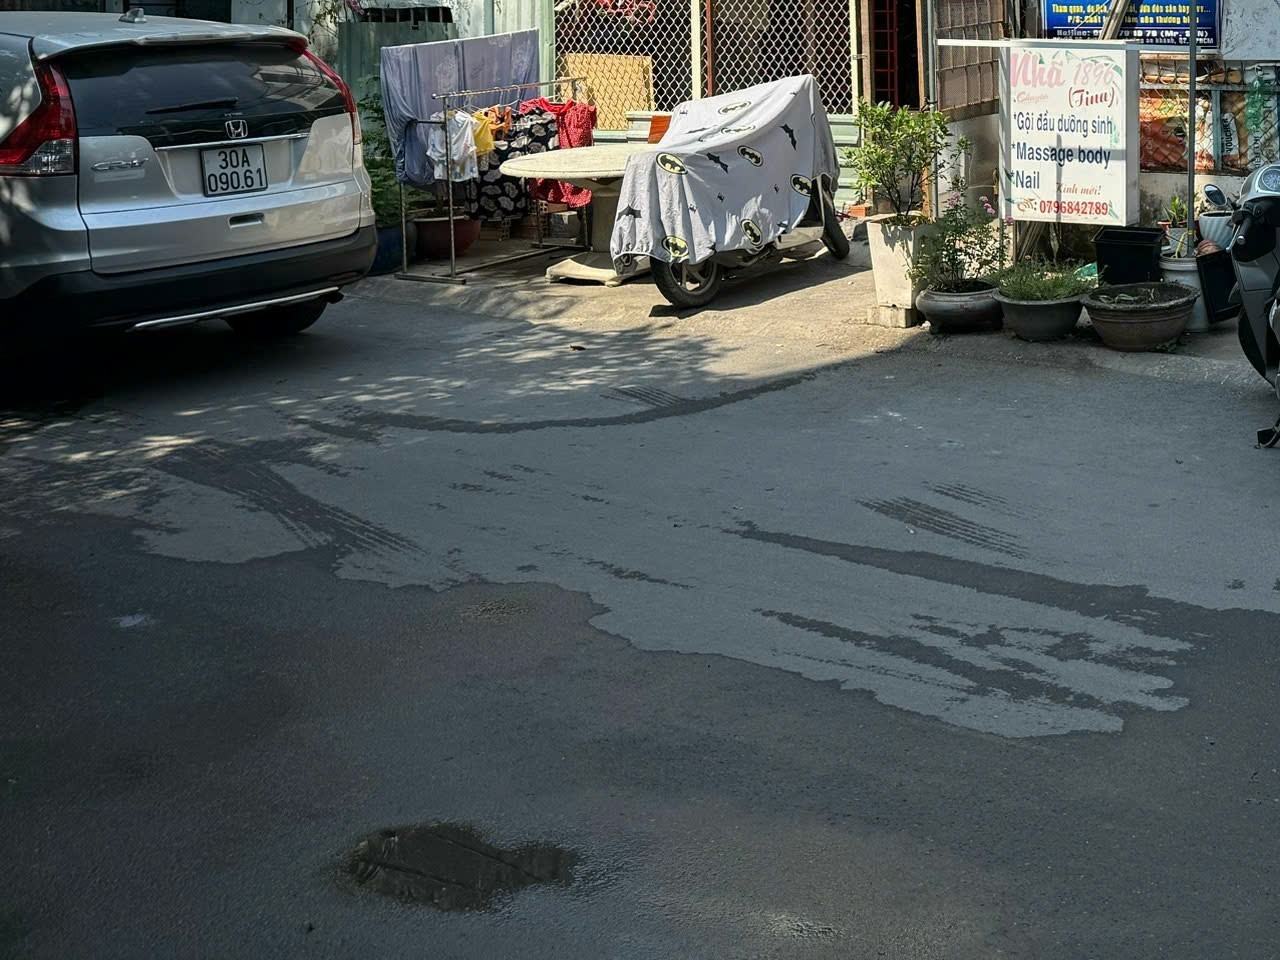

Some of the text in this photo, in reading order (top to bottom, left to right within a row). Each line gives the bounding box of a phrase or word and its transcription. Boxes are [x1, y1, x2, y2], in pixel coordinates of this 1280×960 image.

[1184, 29, 1209, 37] SN)
[1036, 109, 1055, 132] đầu
[1057, 113, 1089, 138] dưỡng
[1091, 115, 1113, 135] sinh
[217, 148, 251, 170] 30A
[1016, 142, 1111, 170] Massage body
[207, 167, 264, 193] 090.61
[1015, 170, 1040, 189] Nail
[1039, 200, 1108, 216] 0796842789
